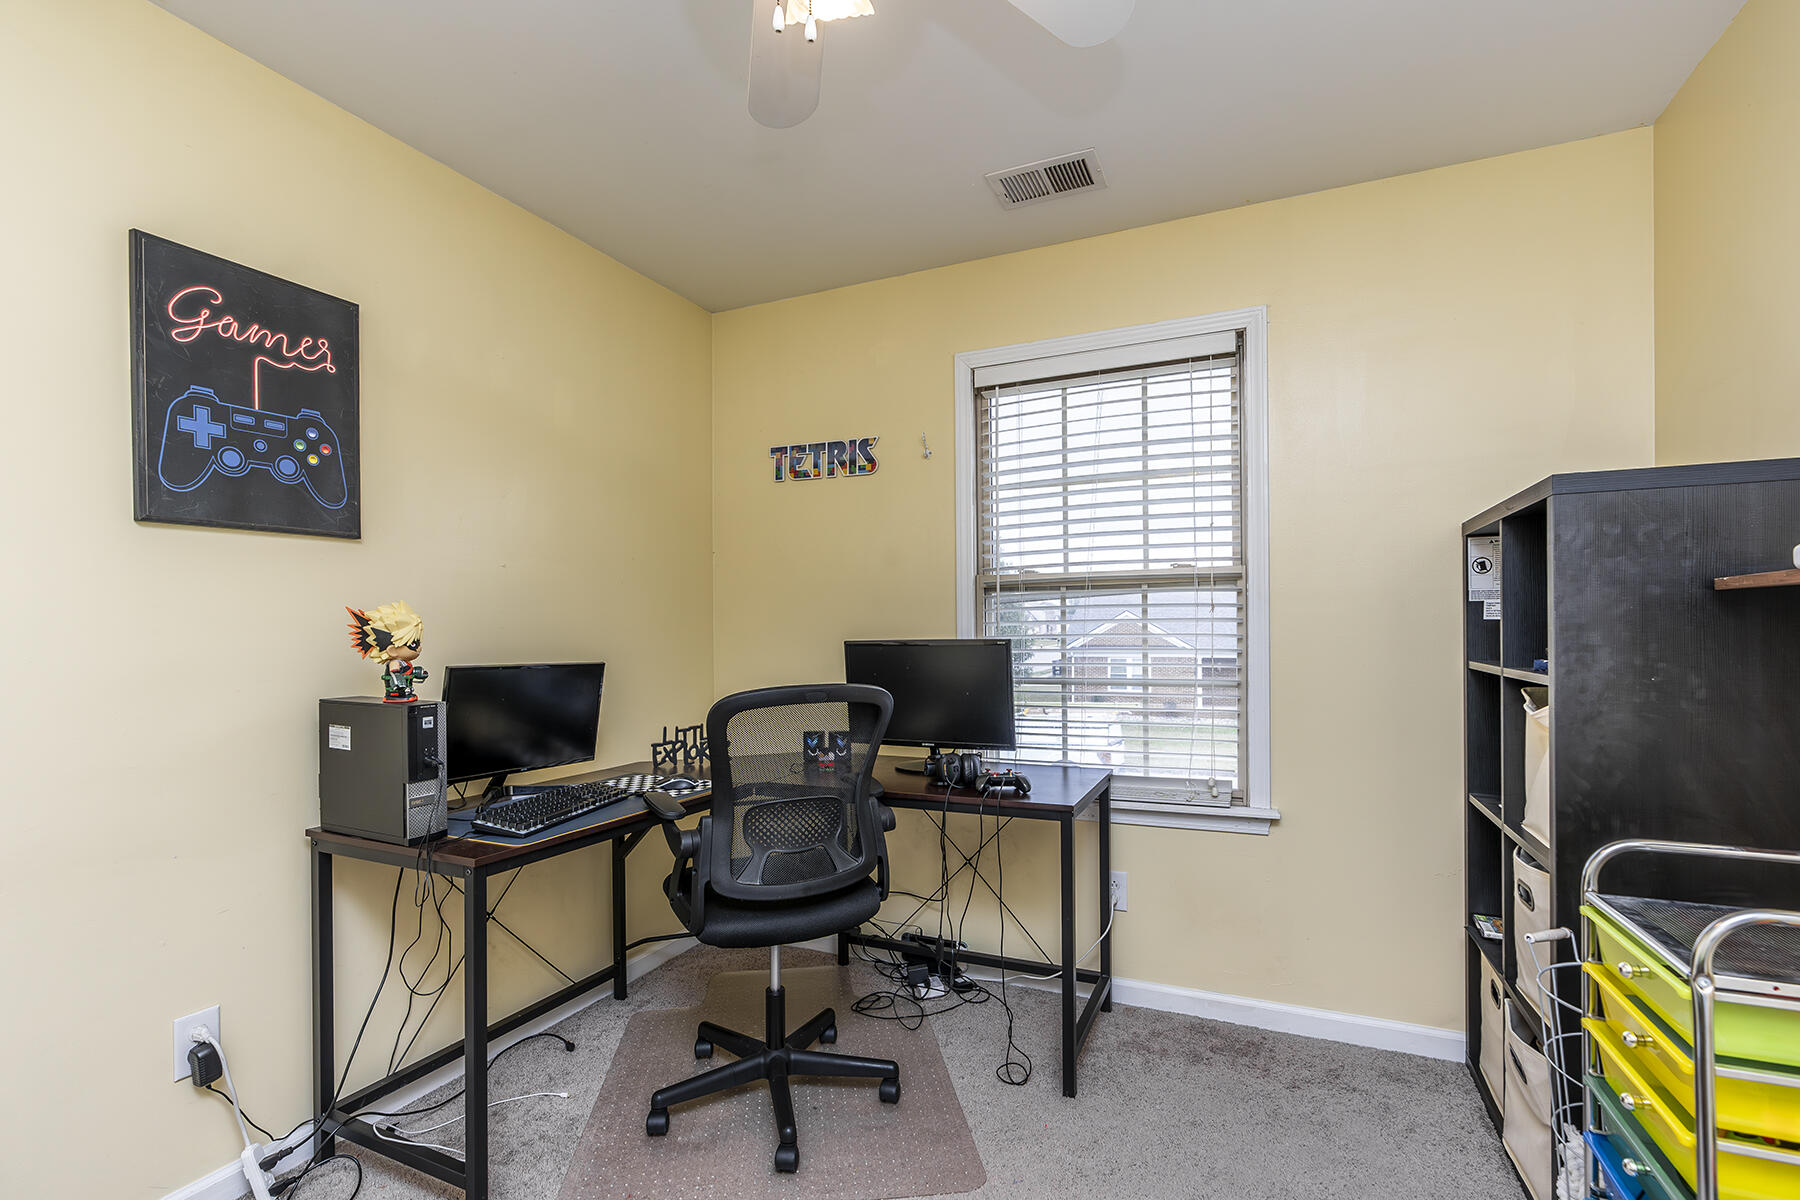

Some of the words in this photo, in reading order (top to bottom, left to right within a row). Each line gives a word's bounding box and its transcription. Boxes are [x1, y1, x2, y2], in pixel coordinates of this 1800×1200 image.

[770, 436, 879, 482] TETRIS
[663, 723, 709, 744] LITTL
[651, 741, 711, 768] EXPLOR
